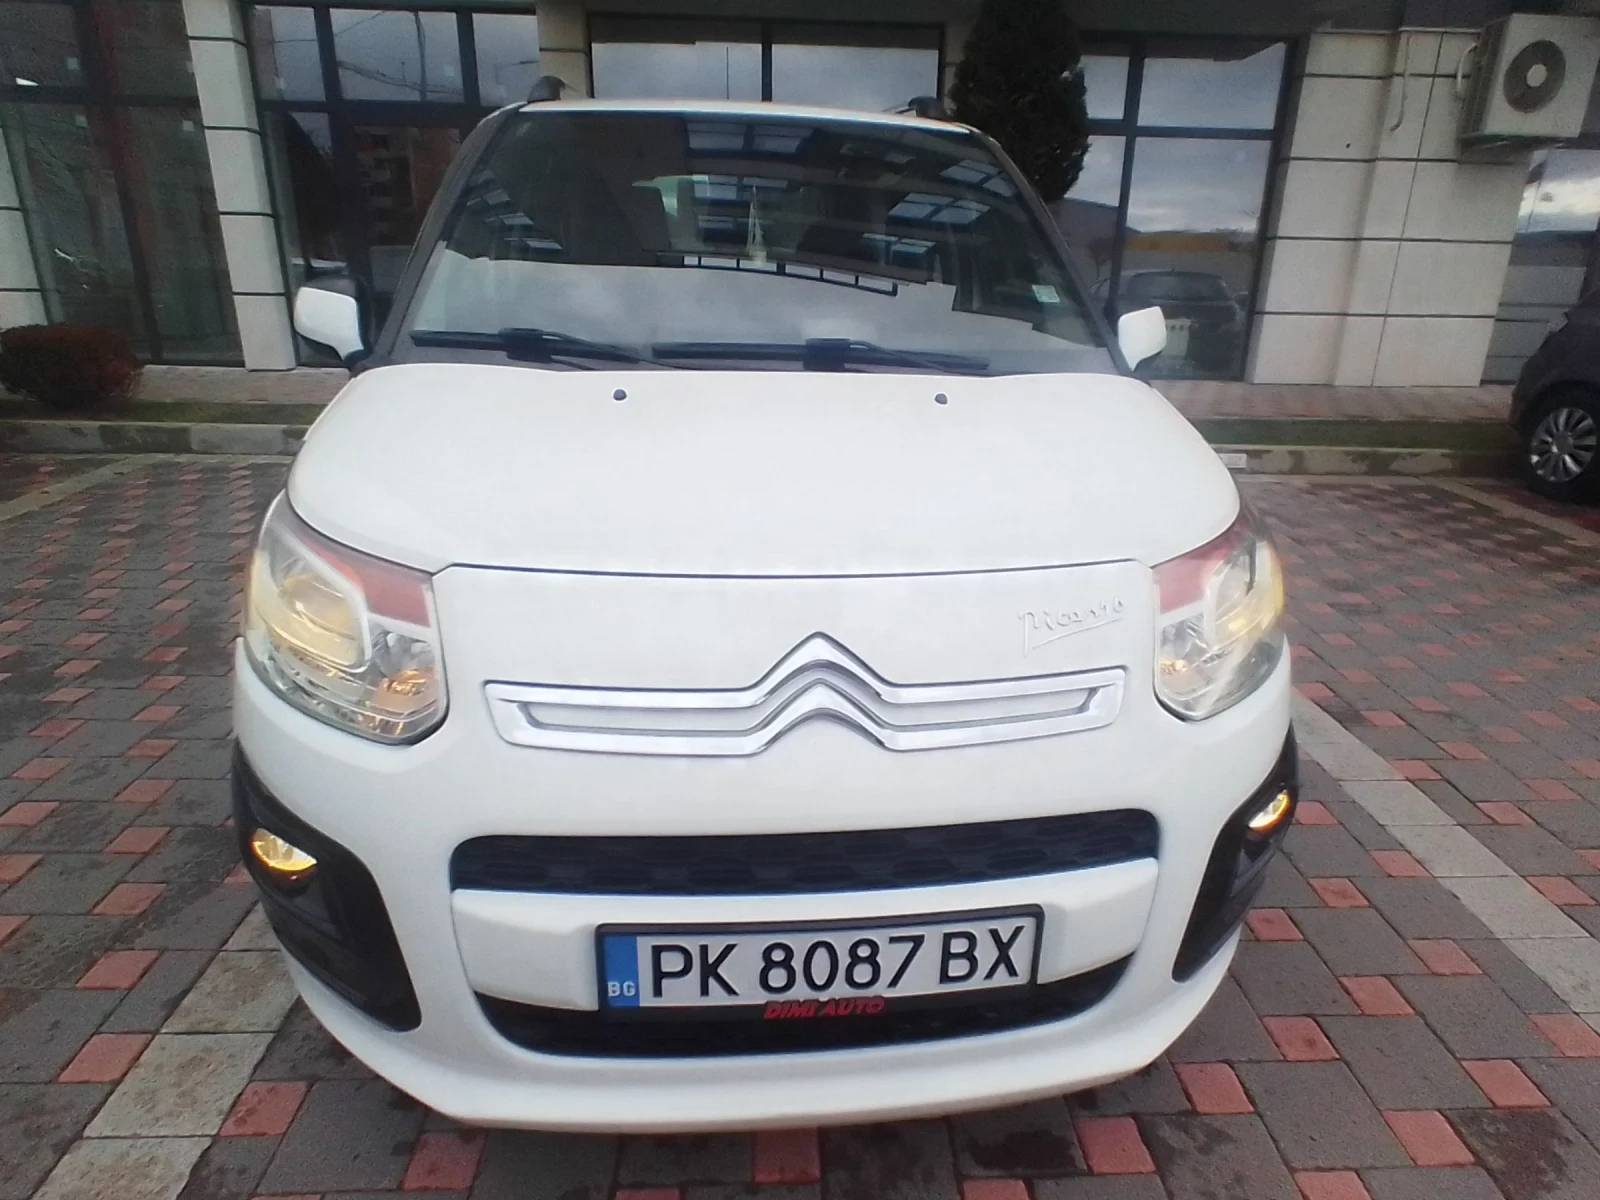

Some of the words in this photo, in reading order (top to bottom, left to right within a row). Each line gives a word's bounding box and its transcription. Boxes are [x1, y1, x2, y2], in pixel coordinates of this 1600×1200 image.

[651, 943, 740, 998] PK
[759, 934, 925, 994] 8087
[939, 925, 1026, 984] BX
[607, 981, 636, 997] BG
[764, 1000, 819, 1019] DIMI
[820, 996, 885, 1016] AUTO
